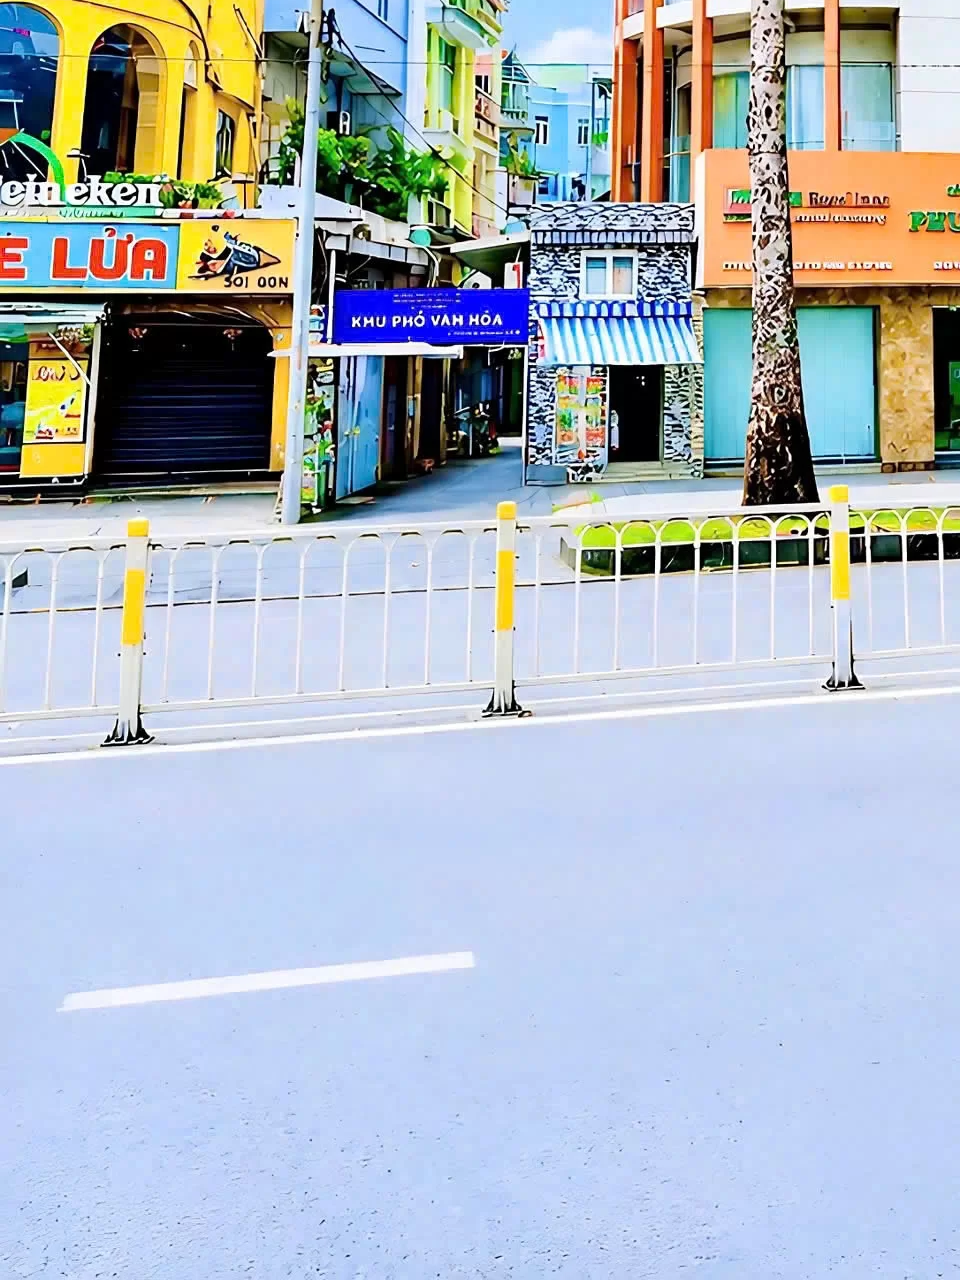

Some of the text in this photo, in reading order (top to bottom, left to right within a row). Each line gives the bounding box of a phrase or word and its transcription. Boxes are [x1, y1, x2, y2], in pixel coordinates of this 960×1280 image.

[0, 173, 164, 207] eineken
[51, 227, 167, 280] LỬA
[351, 317, 386, 328] KHU
